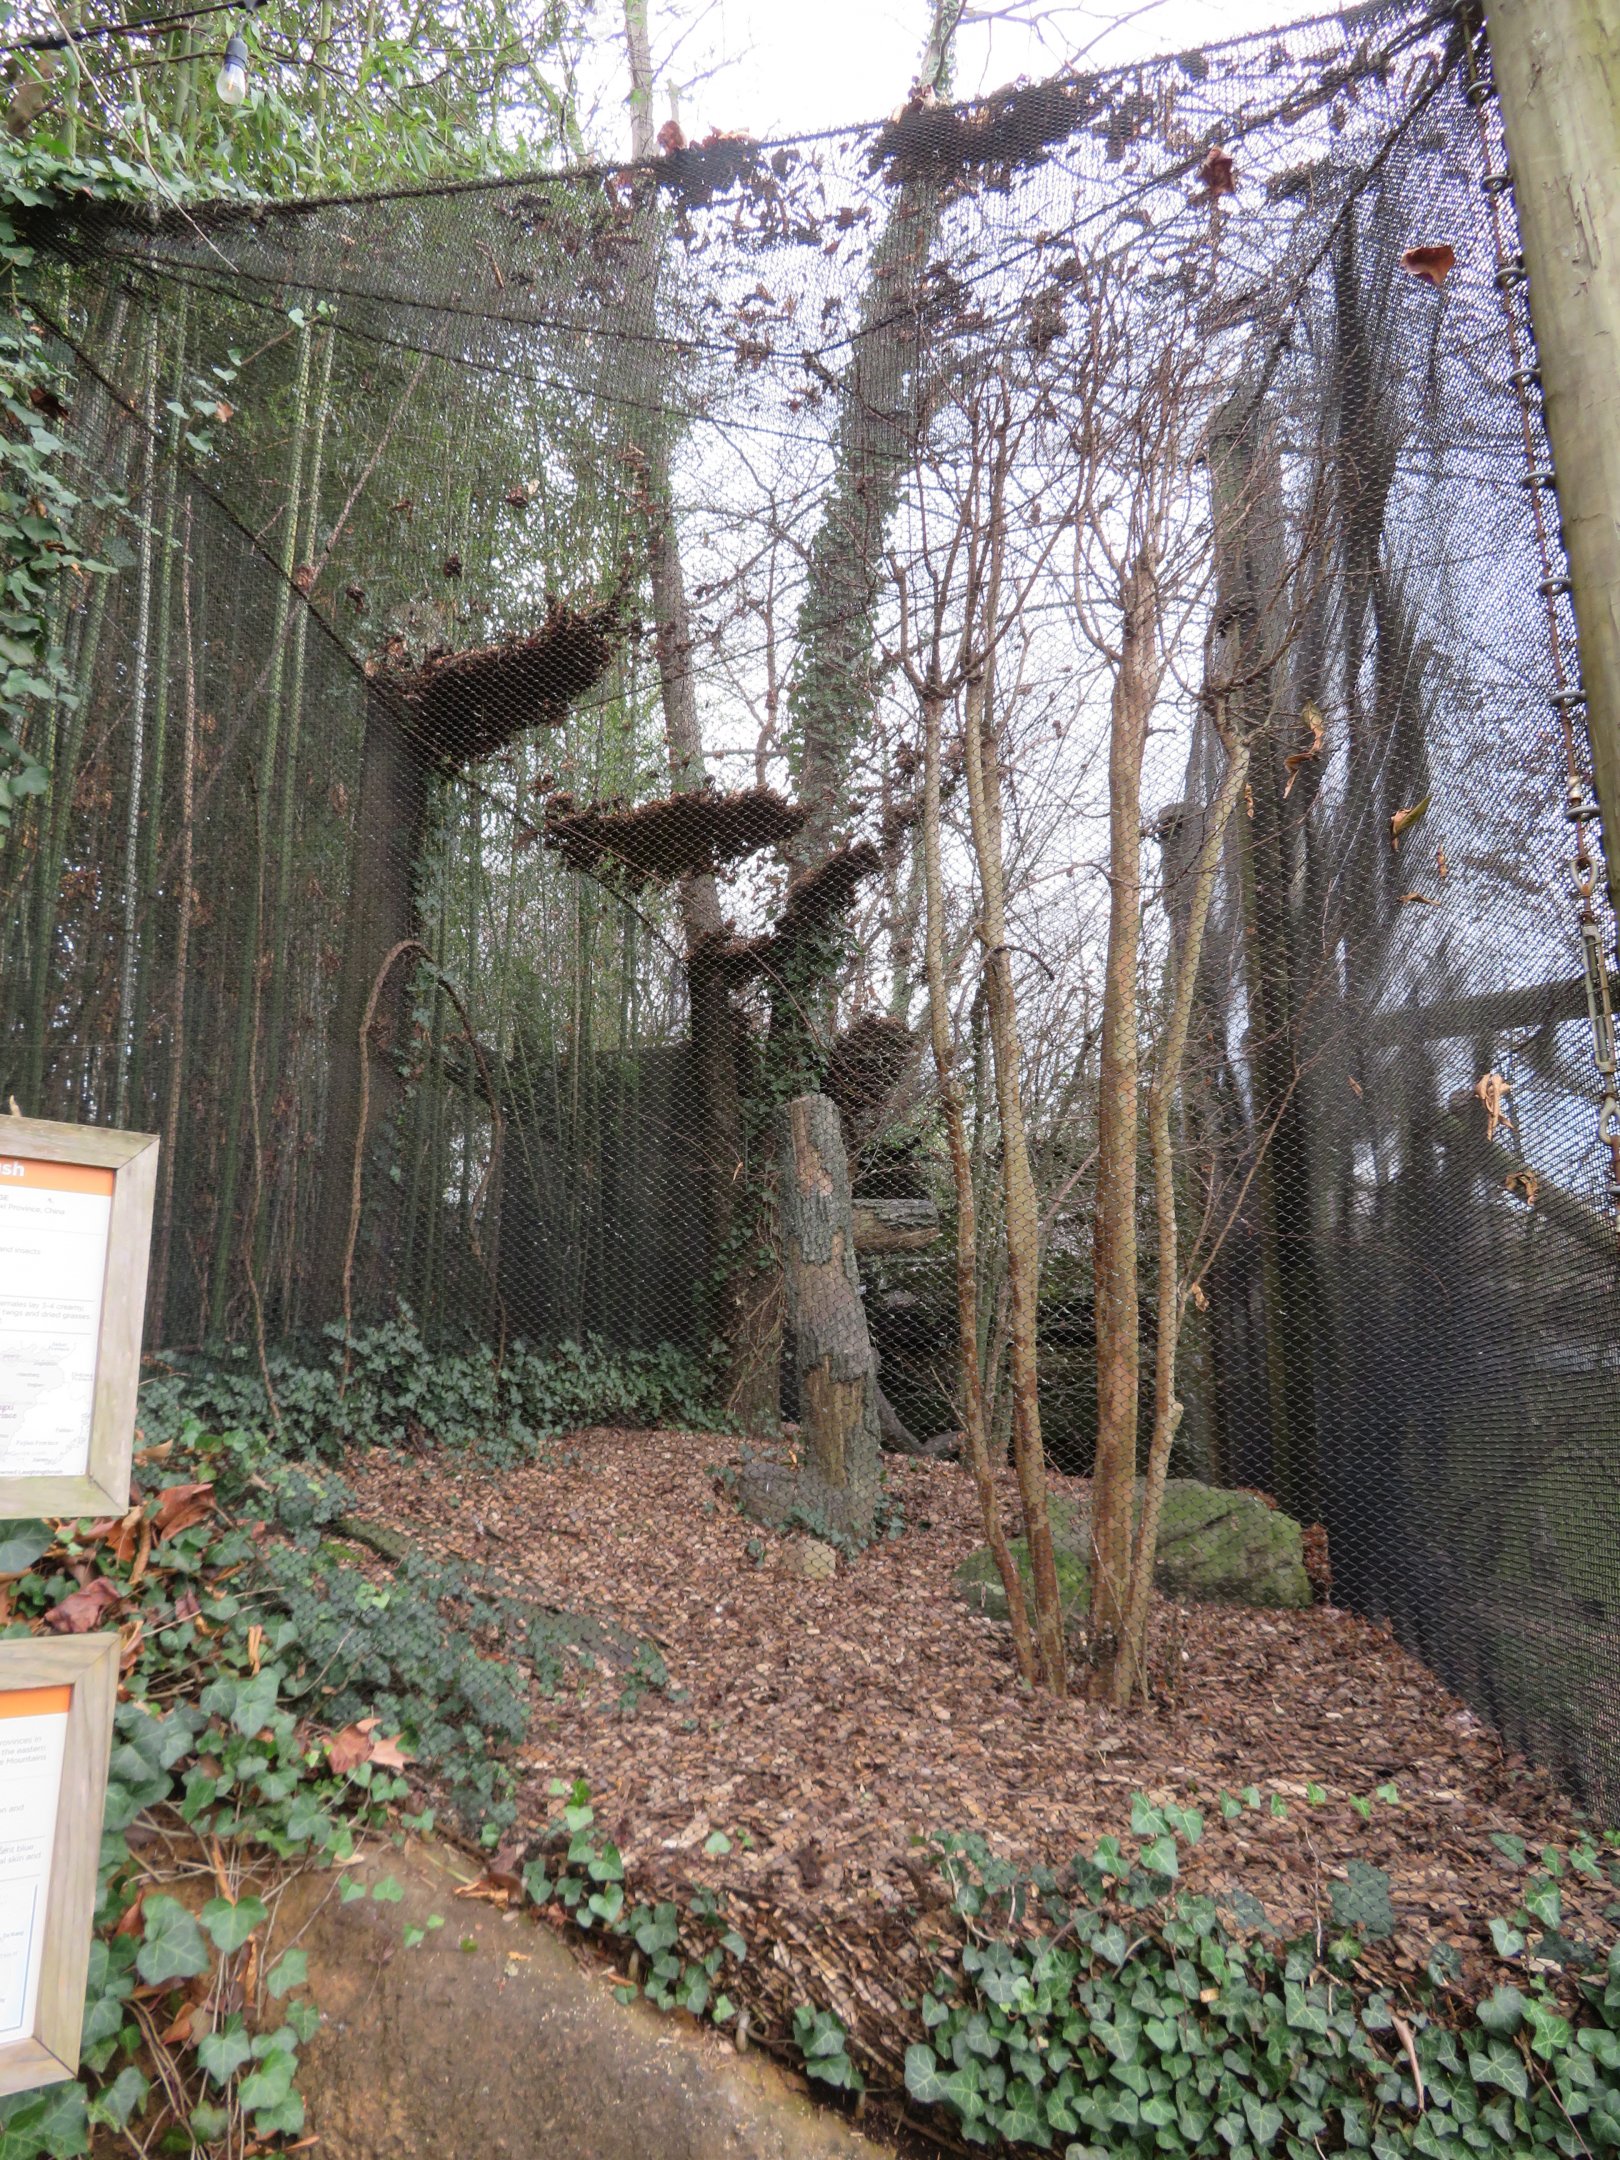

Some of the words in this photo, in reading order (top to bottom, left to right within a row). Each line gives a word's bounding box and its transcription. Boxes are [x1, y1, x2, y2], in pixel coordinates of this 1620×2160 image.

[0, 1161, 24, 1176] sh
[44, 1207, 65, 1215] China
[14, 1246, 41, 1255] insects
[25, 1309, 39, 1317] and
[41, 1310, 61, 1318] dried
[7, 1755, 46, 1764] Mountains
[17, 1844, 34, 1852] blue
